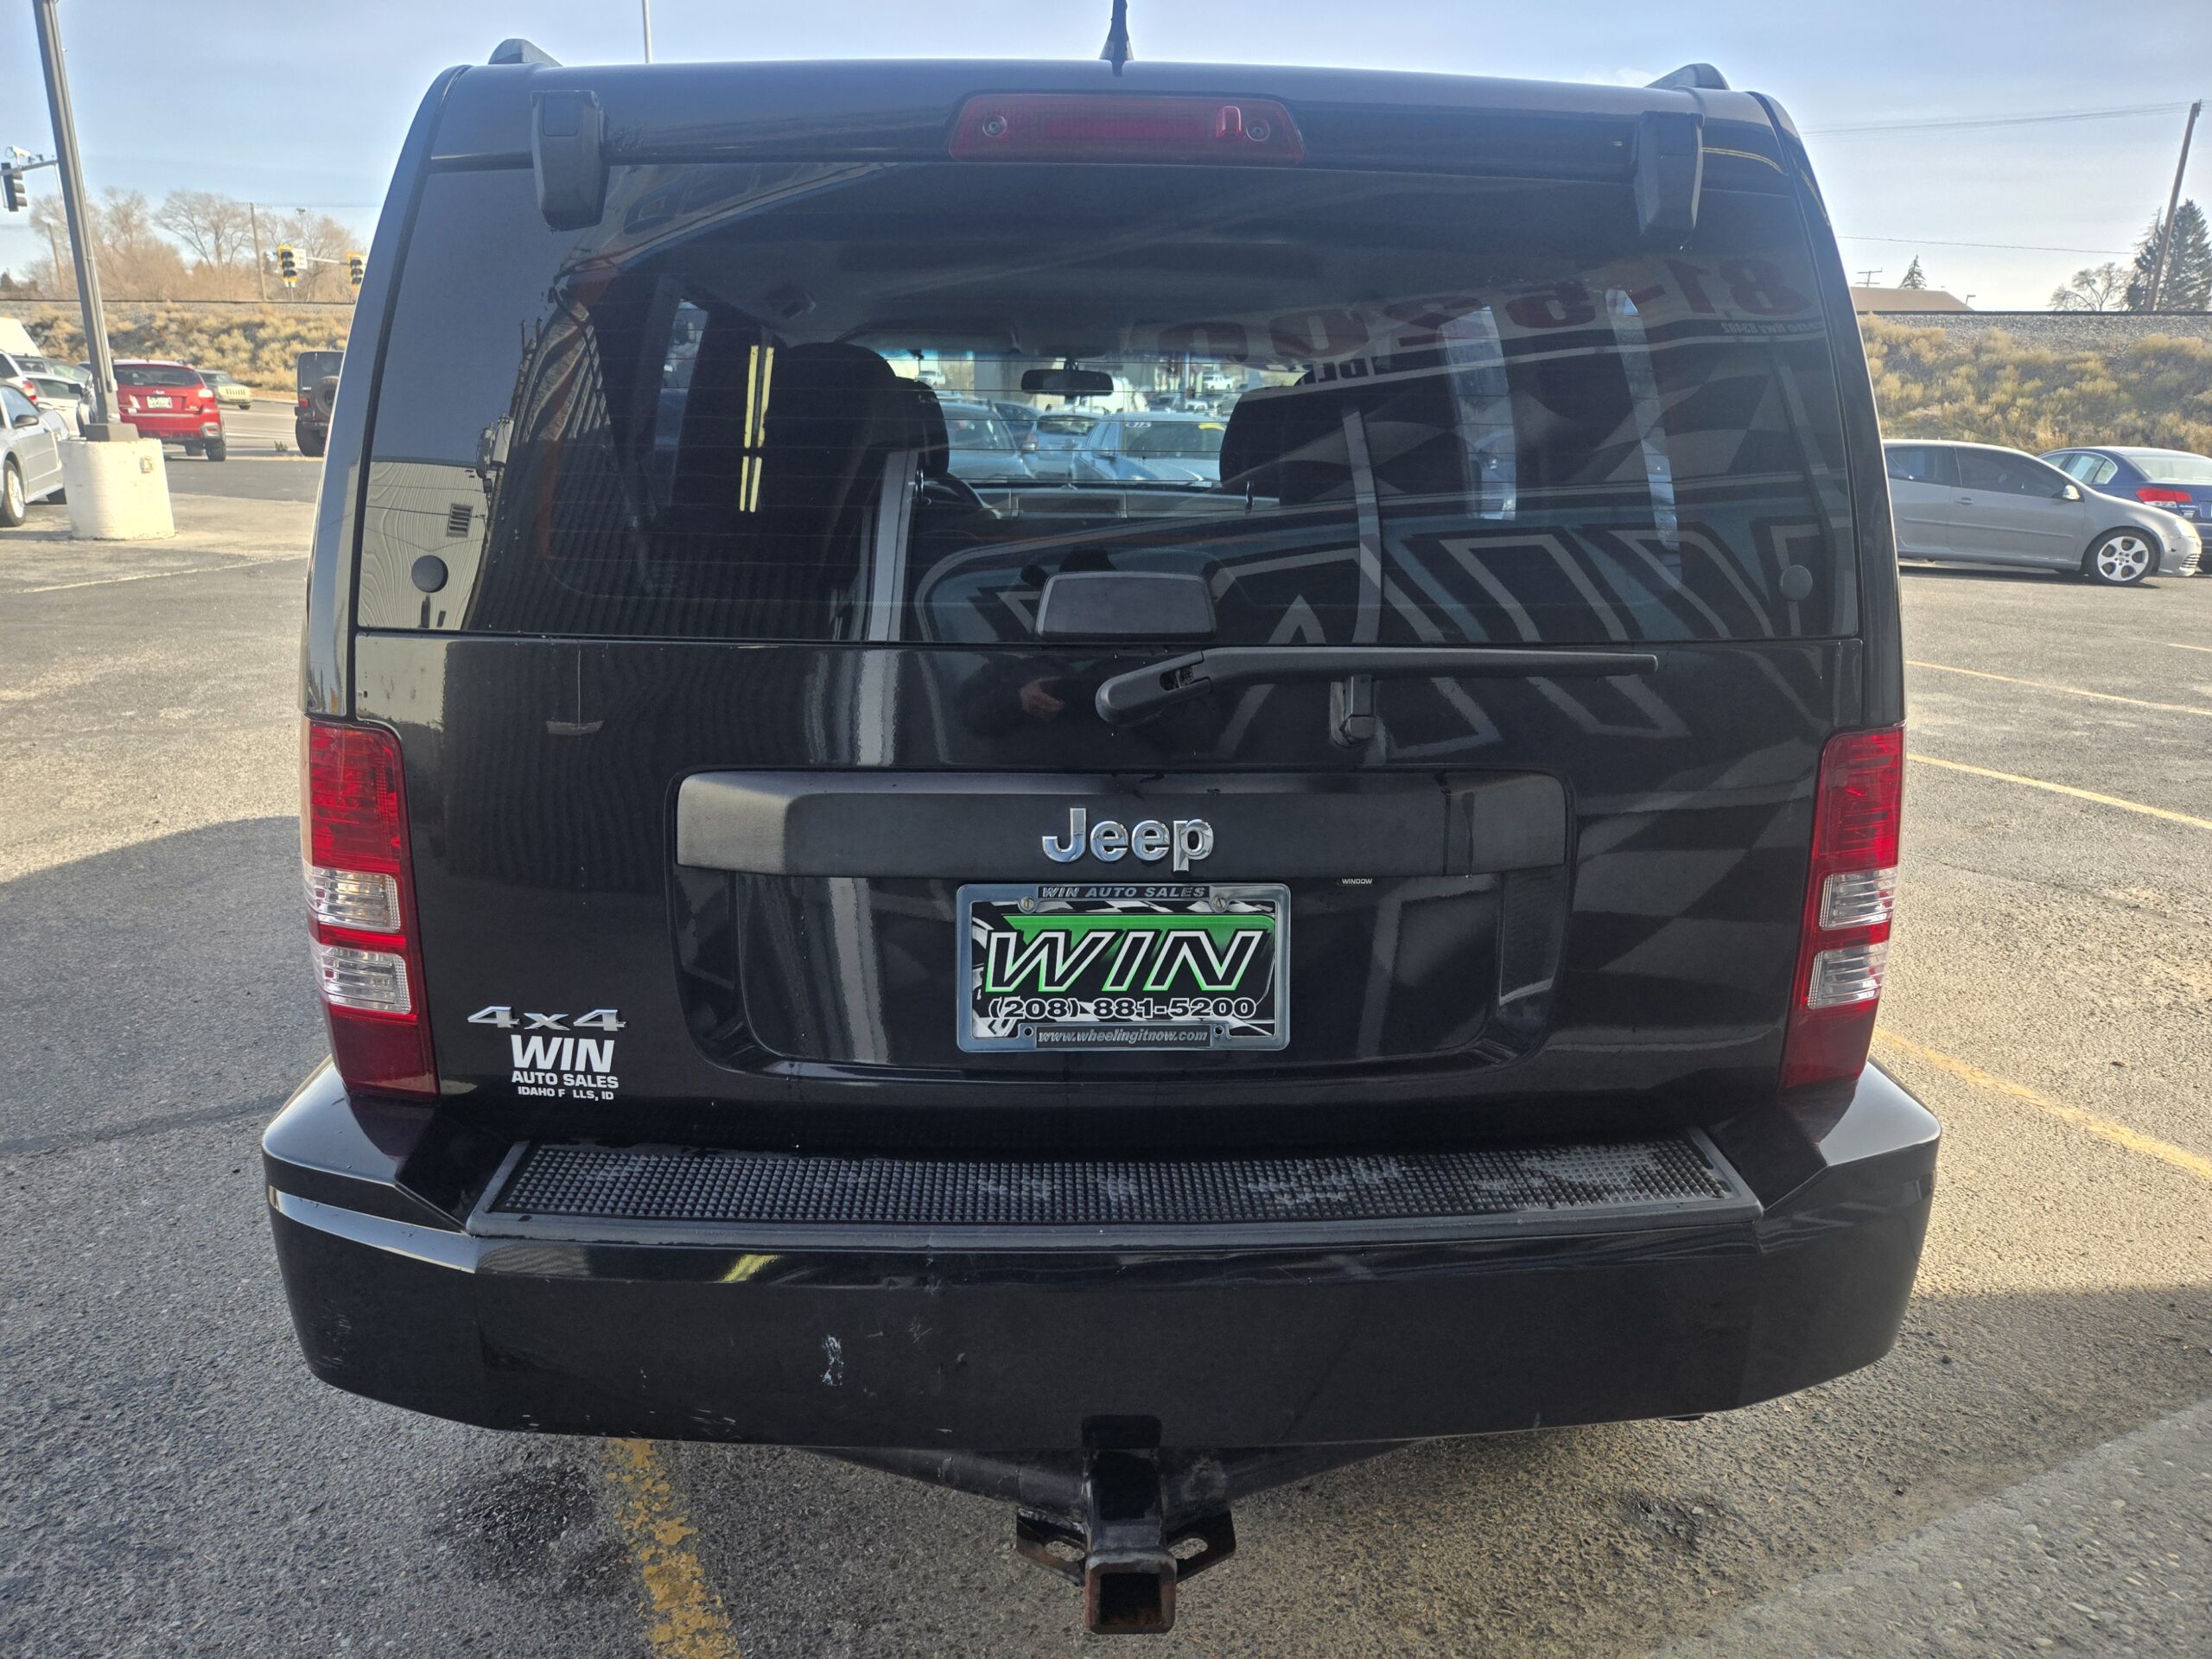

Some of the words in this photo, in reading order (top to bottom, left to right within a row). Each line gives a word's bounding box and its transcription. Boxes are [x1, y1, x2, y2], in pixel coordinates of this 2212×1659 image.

[1042, 808, 1215, 872] Jeep
[1042, 887, 1080, 898] WIN
[1085, 887, 1137, 898] AUTO
[1144, 887, 1207, 898] SALES
[985, 930, 1264, 993] WIN
[467, 1006, 627, 1032] 4x4
[988, 996, 1080, 1020] (208)
[1092, 996, 1256, 1020] 881-5200
[1038, 1027, 1208, 1044] www.wheelingitnow.com
[511, 1034, 615, 1073] WIN
[512, 1071, 558, 1085] AUTO
[563, 1073, 620, 1089] SALES
[518, 1086, 556, 1097] IDAHO
[558, 1089, 599, 1101] FLLS,
[601, 1090, 614, 1101] ID
